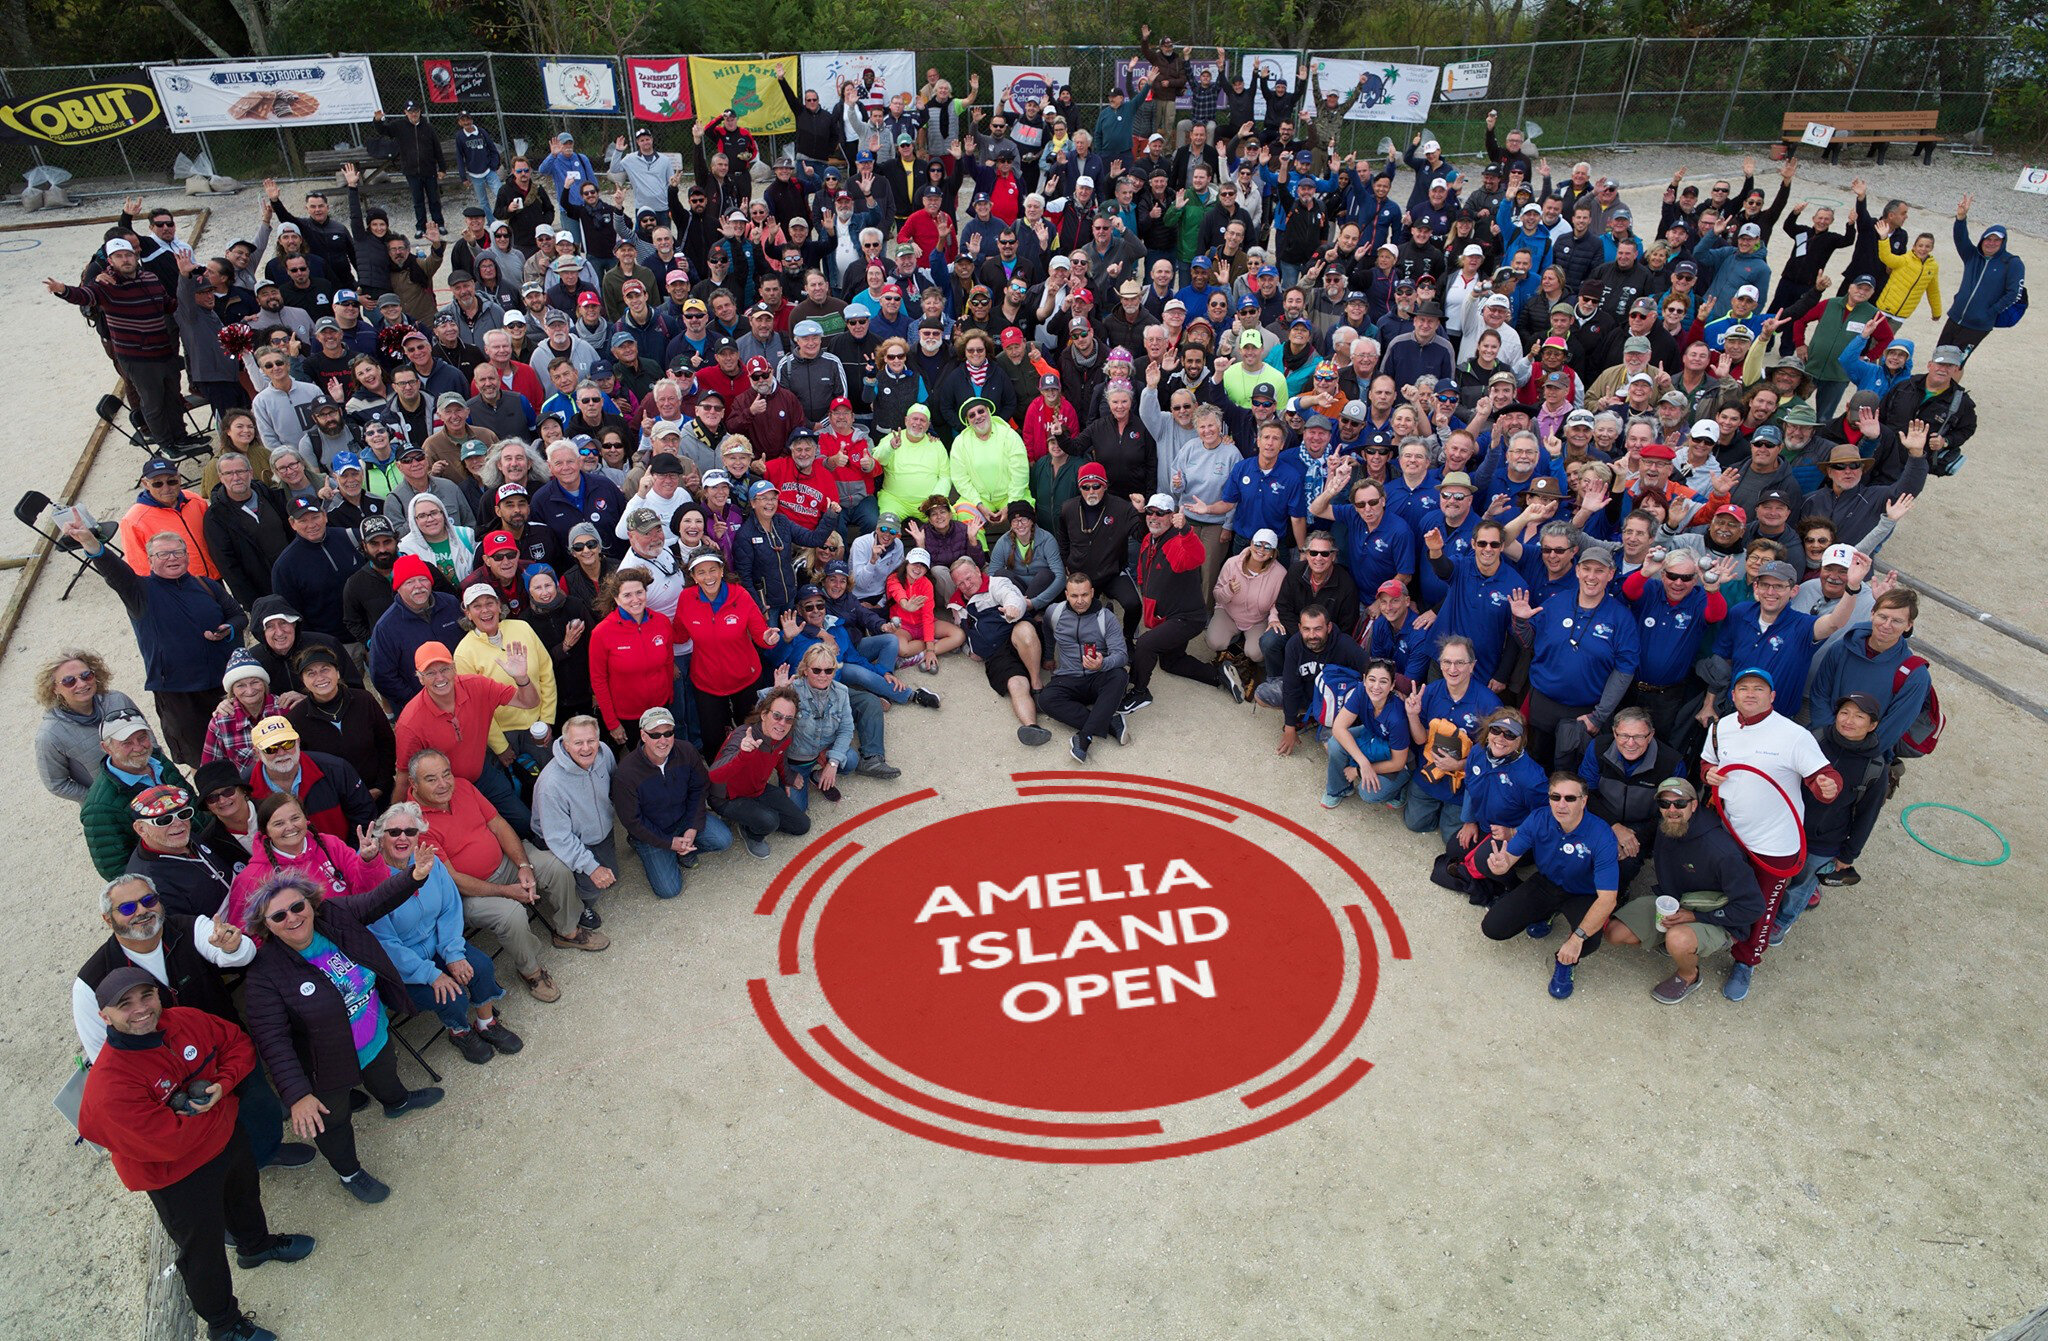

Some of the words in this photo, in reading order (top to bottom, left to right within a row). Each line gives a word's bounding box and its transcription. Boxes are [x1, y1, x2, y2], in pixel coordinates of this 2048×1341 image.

[224, 72, 253, 84] JULES
[256, 69, 313, 82] DESTROOPER
[713, 65, 740, 79] Mill
[748, 64, 778, 78] Park
[1122, 64, 1146, 77] Cme
[30, 88, 134, 136] OBUT
[765, 116, 790, 131] Club
[261, 722, 285, 735] LSU
[1767, 878, 1786, 912] TOMMY
[1752, 925, 1769, 960] HILFIGE
[302, 984, 314, 994] 139
[185, 1048, 195, 1059] 109
